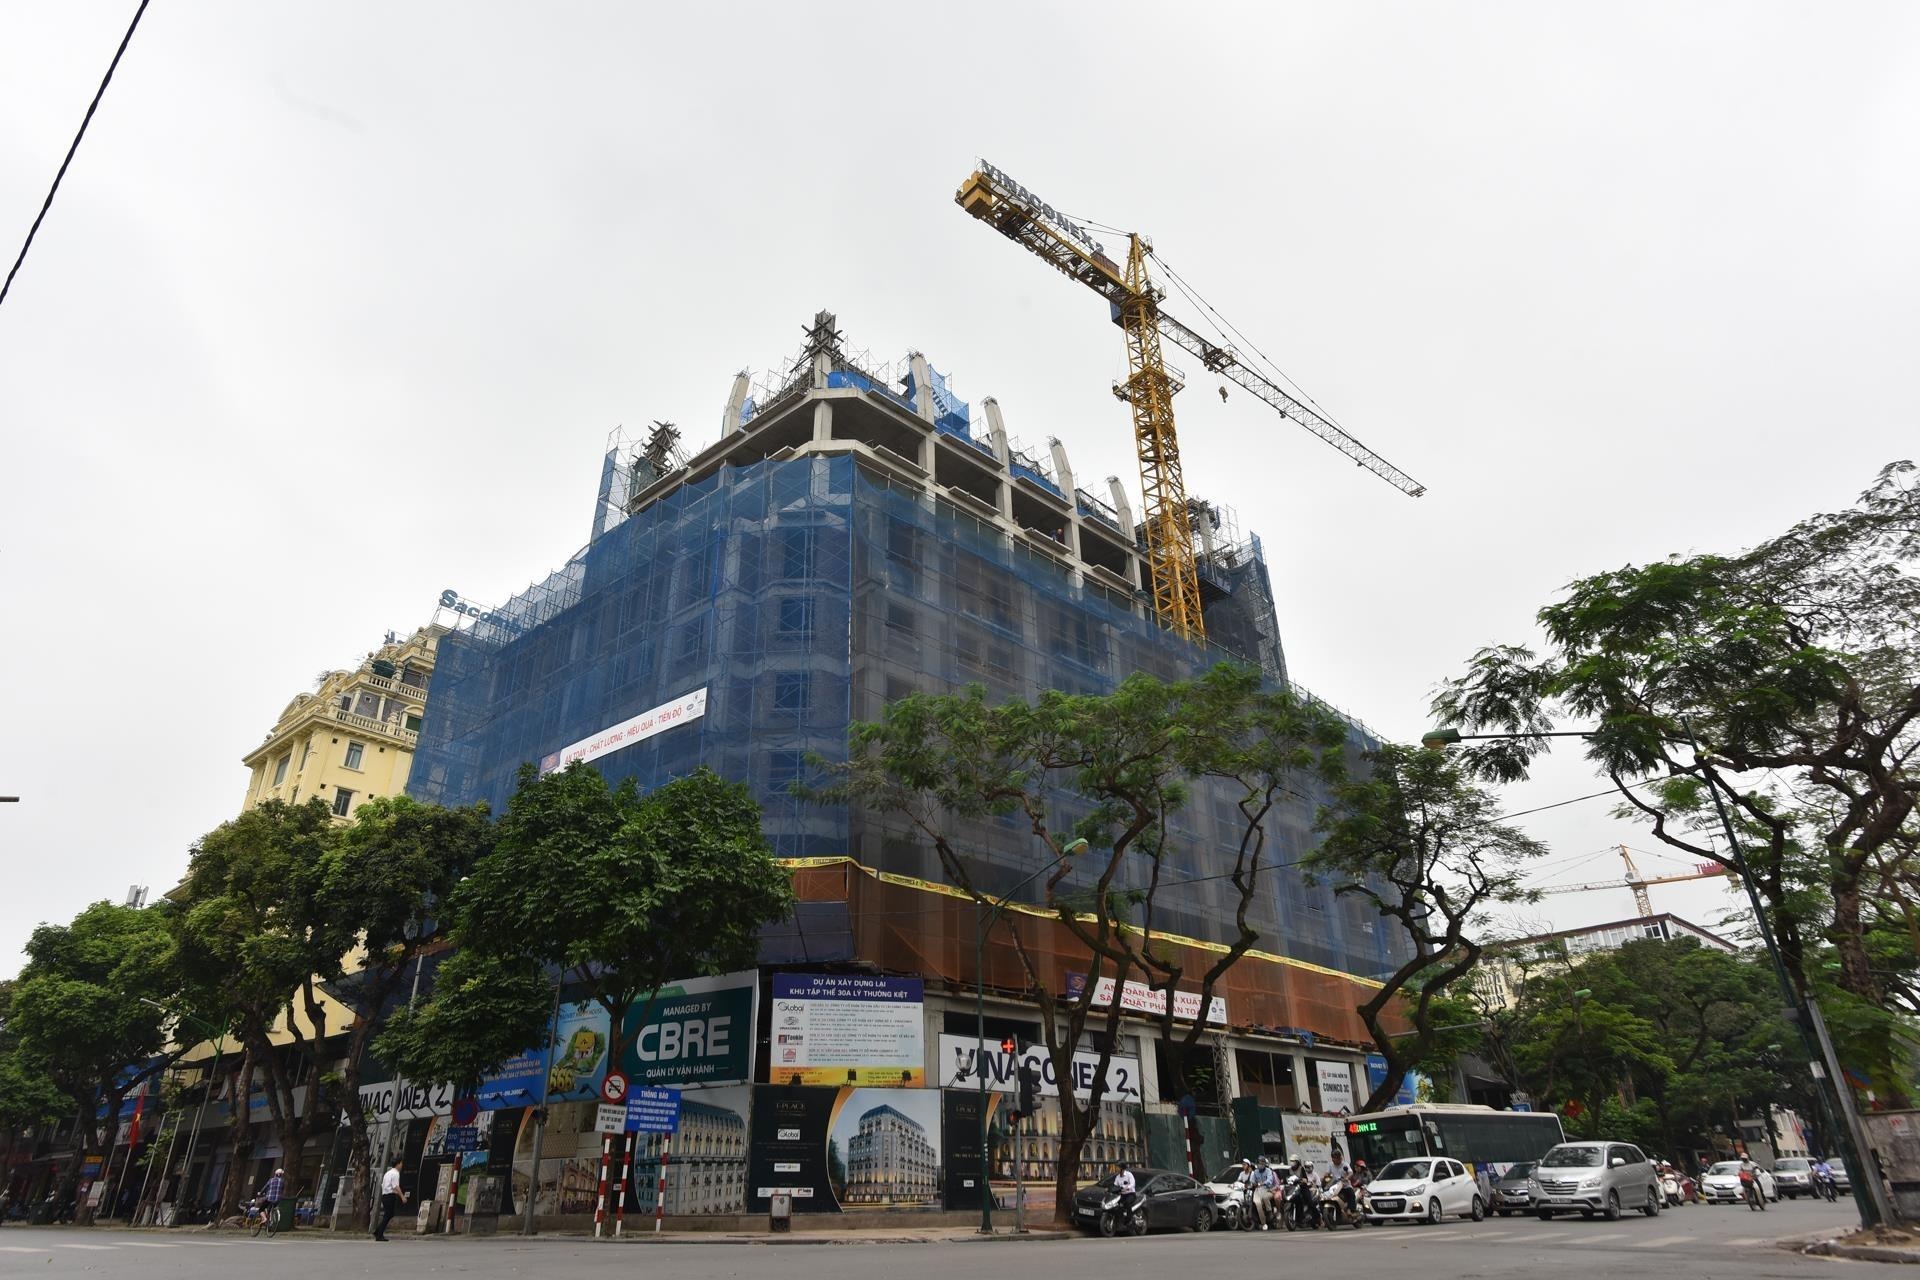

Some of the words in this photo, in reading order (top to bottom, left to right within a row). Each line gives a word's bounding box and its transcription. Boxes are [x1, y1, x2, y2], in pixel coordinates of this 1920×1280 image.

[982, 158, 1095, 251] VINACONEX
[826, 978, 836, 986] ÁN
[837, 978, 852, 987] XÂY
[806, 988, 821, 996] TẬP
[823, 987, 836, 996] THỂ
[893, 991, 908, 999] KIỆT
[1123, 986, 1145, 998] OÀN
[662, 1004, 700, 1017] MANAGED
[701, 1002, 712, 1012] BY
[1149, 1001, 1167, 1012] PHẢ
[636, 1016, 731, 1061] CBRE
[646, 1066, 666, 1078] QUẢN
[667, 1065, 675, 1076] LÝ
[676, 1065, 692, 1078] VẬN
[693, 1064, 715, 1074] HÀNH
[955, 1047, 1111, 1094] VINACOEX
[1116, 1068, 1129, 1093] 2
